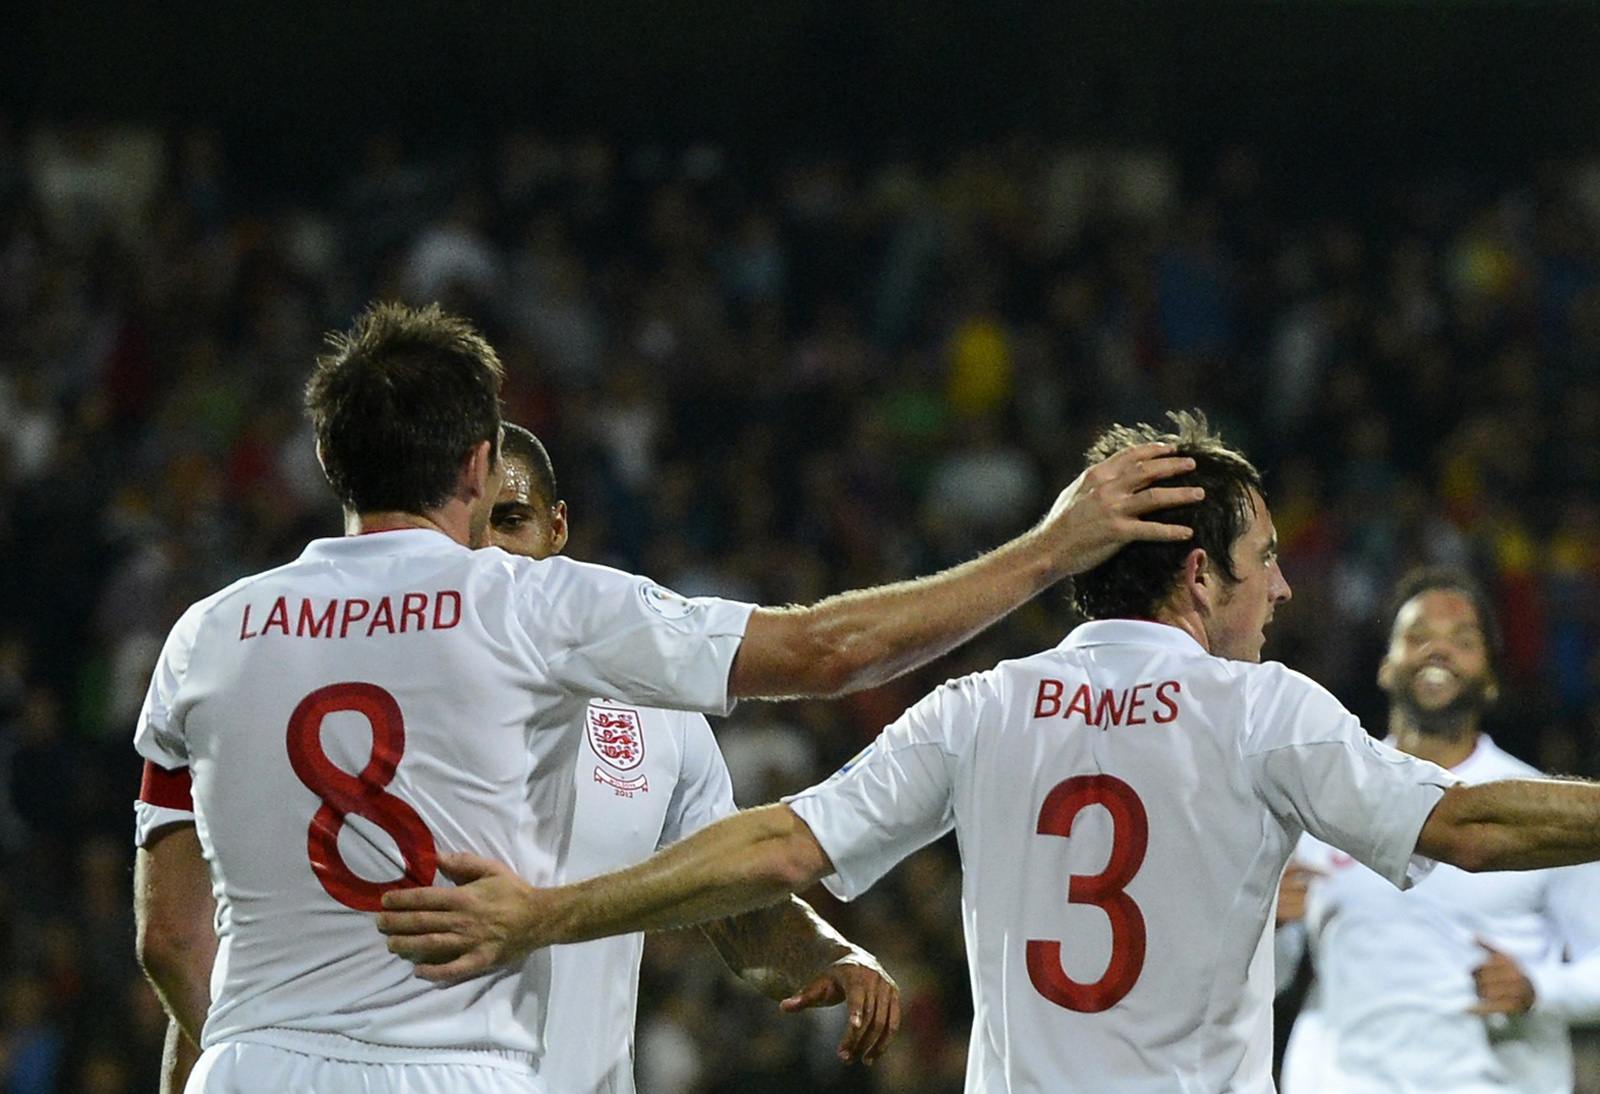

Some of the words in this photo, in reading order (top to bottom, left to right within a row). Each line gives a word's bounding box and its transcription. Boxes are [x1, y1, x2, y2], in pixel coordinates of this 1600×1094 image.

[239, 590, 462, 641] LAMPARD
[286, 682, 437, 912] 8
[1025, 773, 1149, 1013] 3
